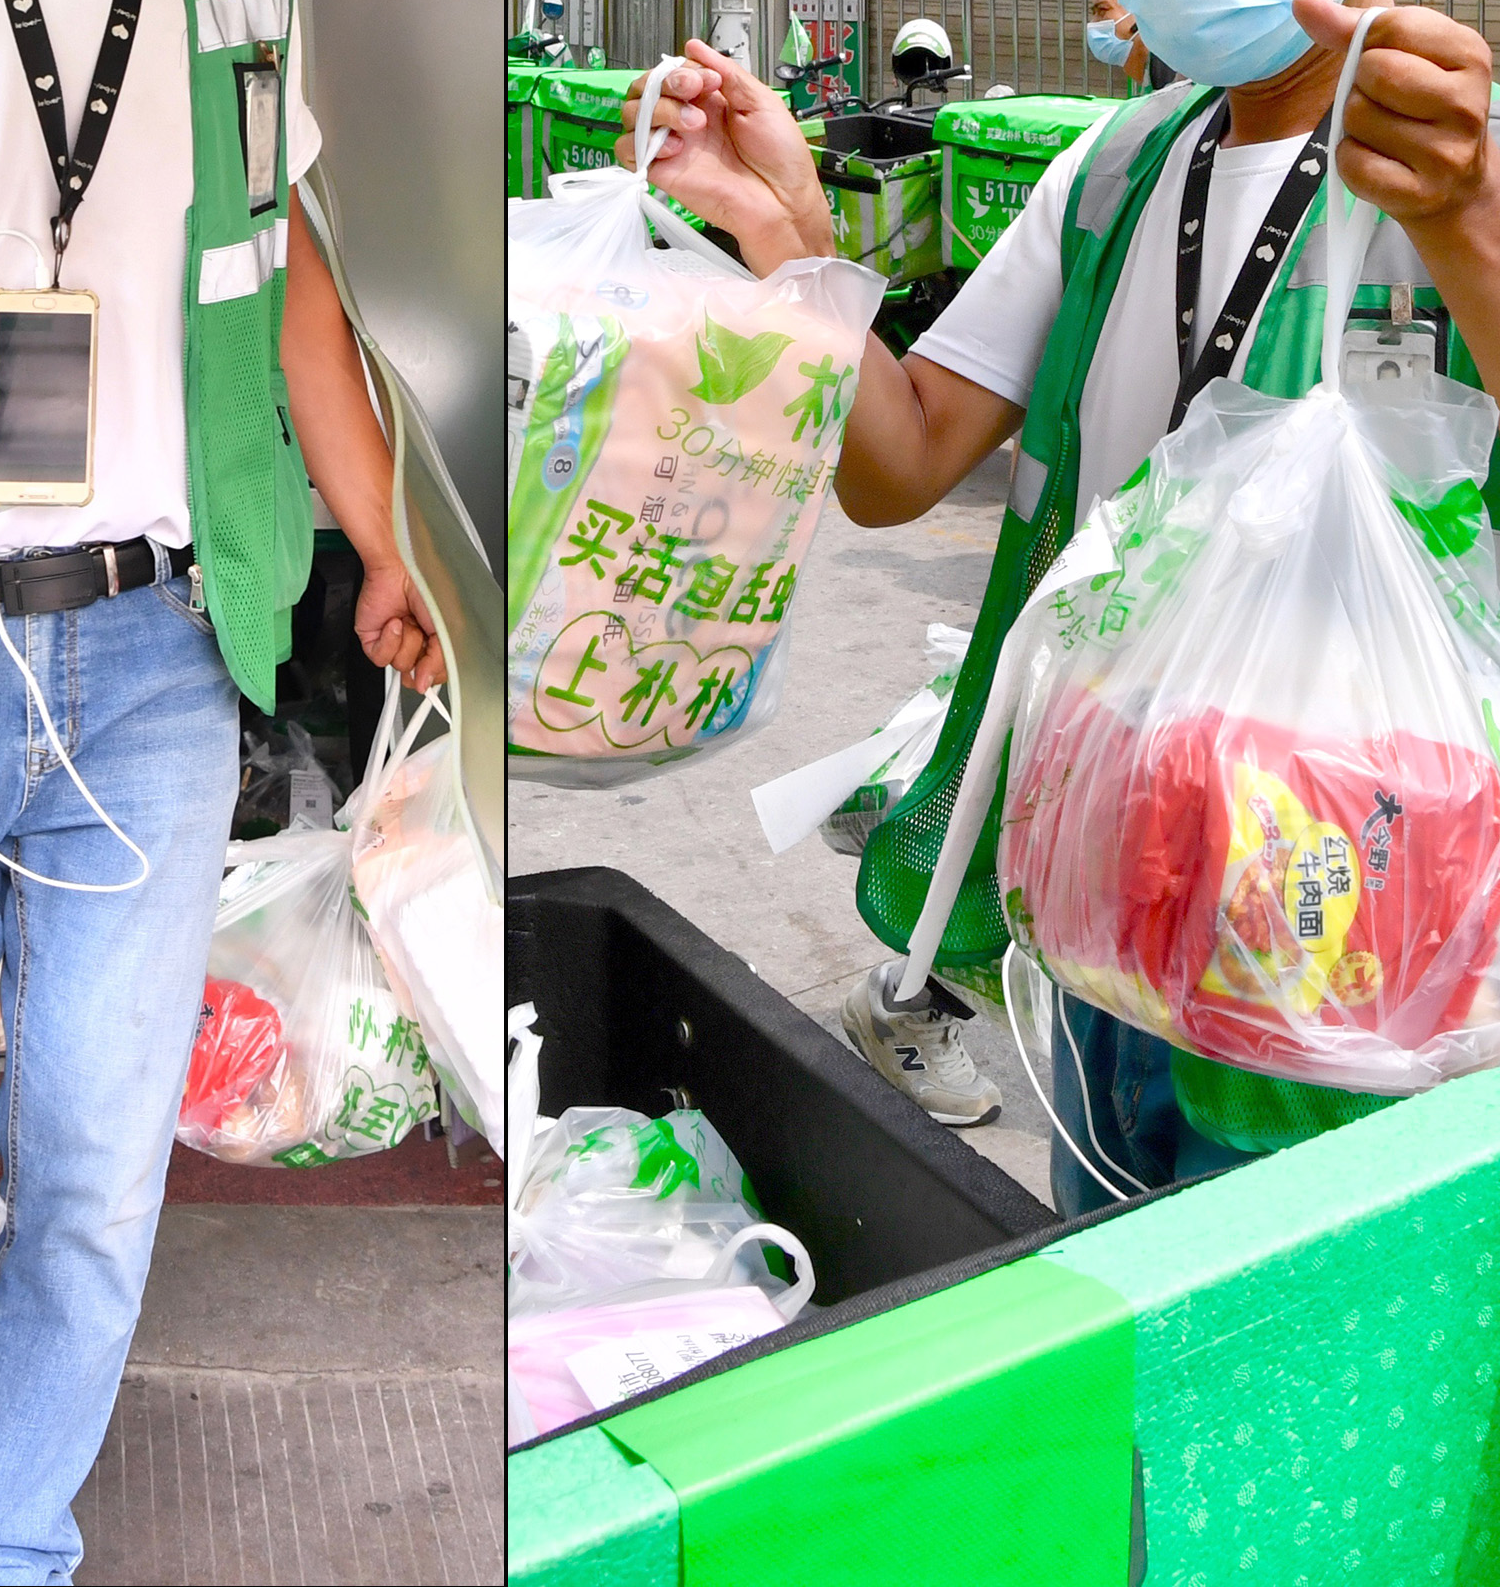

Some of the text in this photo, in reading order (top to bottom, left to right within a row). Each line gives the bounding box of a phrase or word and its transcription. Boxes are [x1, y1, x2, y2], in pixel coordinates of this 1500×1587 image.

[571, 144, 612, 166] 51690
[1297, 851, 1324, 939] 牛肉面
[1324, 834, 1353, 896] 红烧
